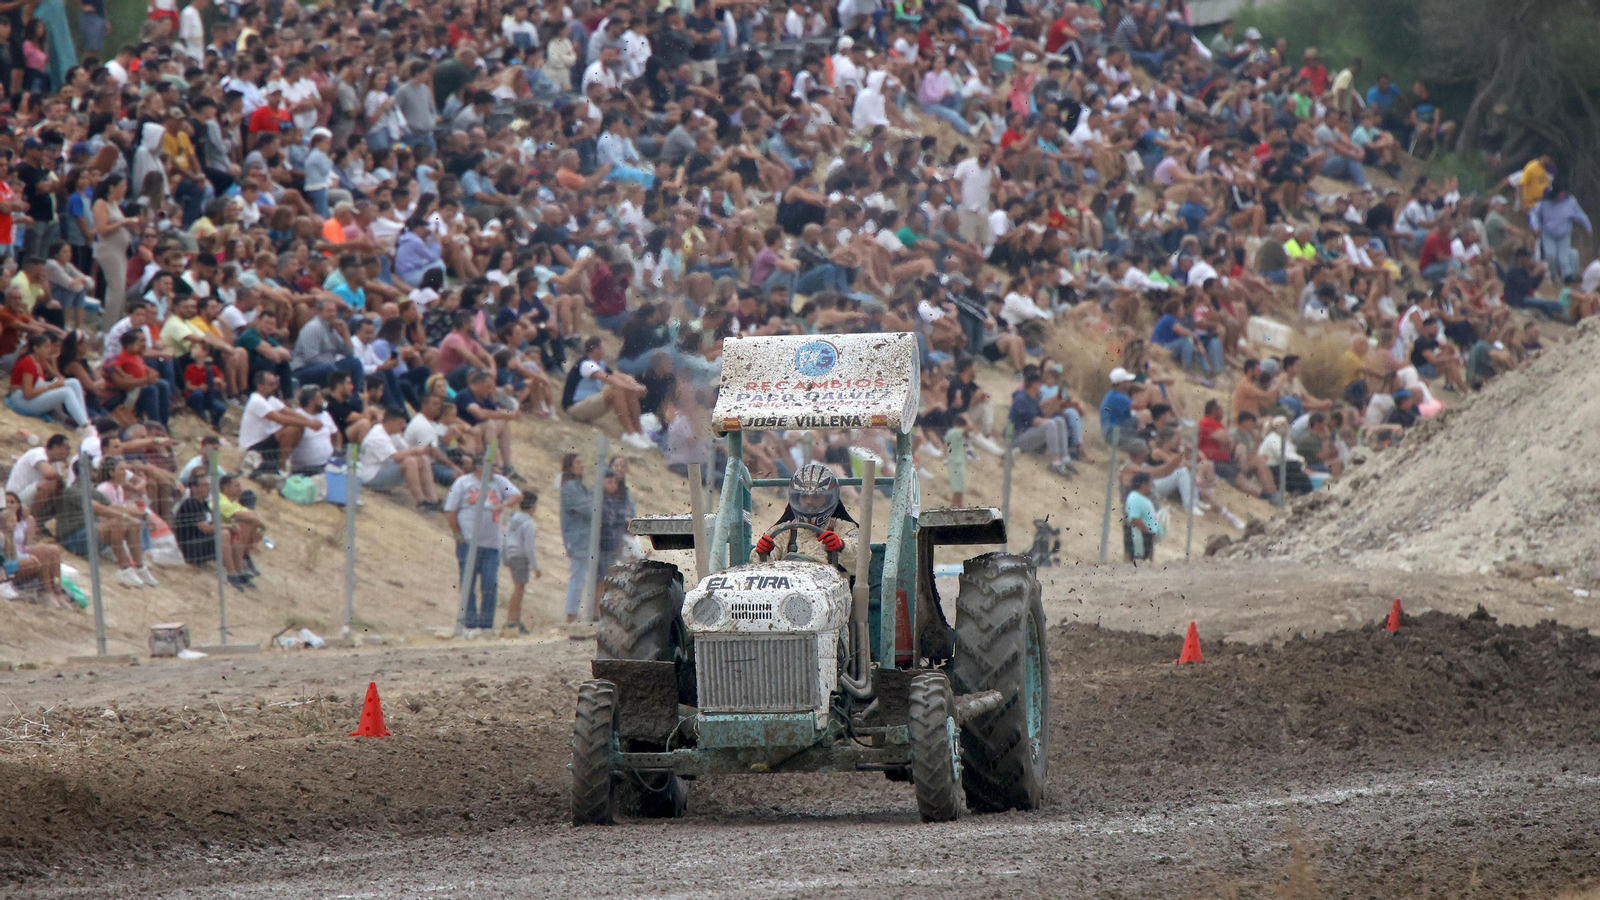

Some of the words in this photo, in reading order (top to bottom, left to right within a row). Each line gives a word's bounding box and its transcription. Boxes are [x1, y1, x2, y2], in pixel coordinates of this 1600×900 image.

[745, 378, 885, 391] RECAMBIOS
[736, 393, 794, 403] PACO
[795, 415, 862, 427] VILLENA
[706, 577, 734, 591] EL
[745, 576, 790, 590] TIRA
